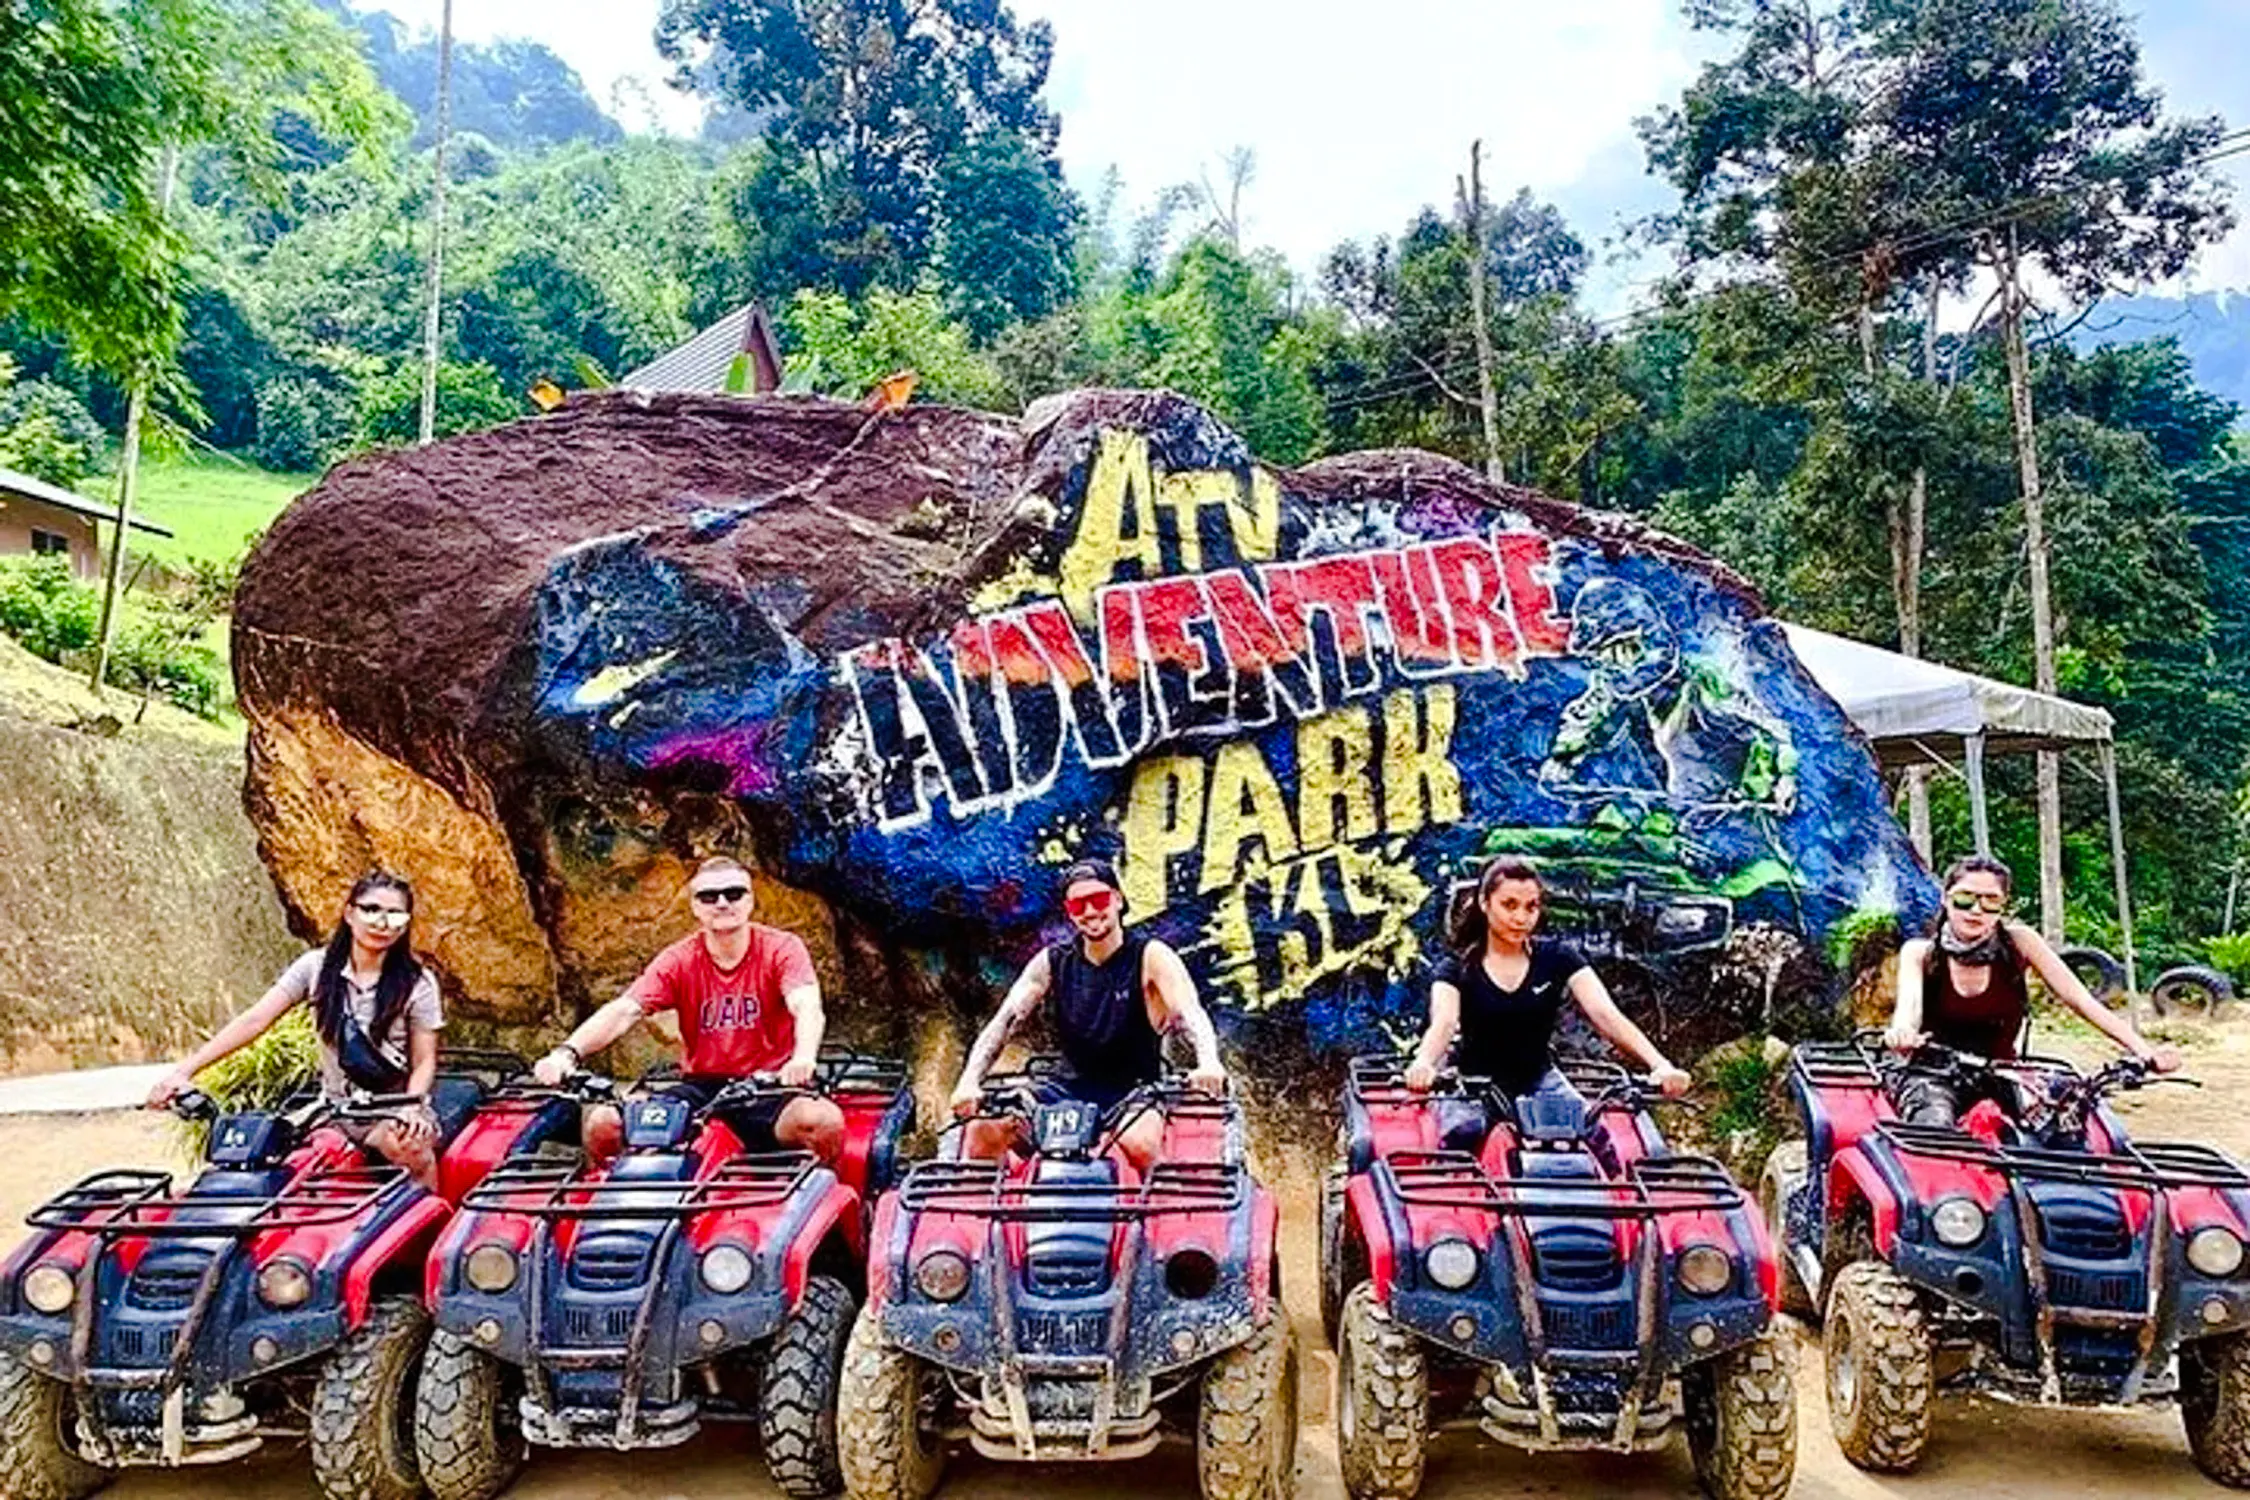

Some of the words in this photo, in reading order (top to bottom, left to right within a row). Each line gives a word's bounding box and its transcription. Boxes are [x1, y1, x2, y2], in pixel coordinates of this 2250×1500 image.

[1059, 427, 1280, 624] ATV
[842, 529, 1572, 834] ADVENTURE
[1118, 685, 1464, 925] PARK
